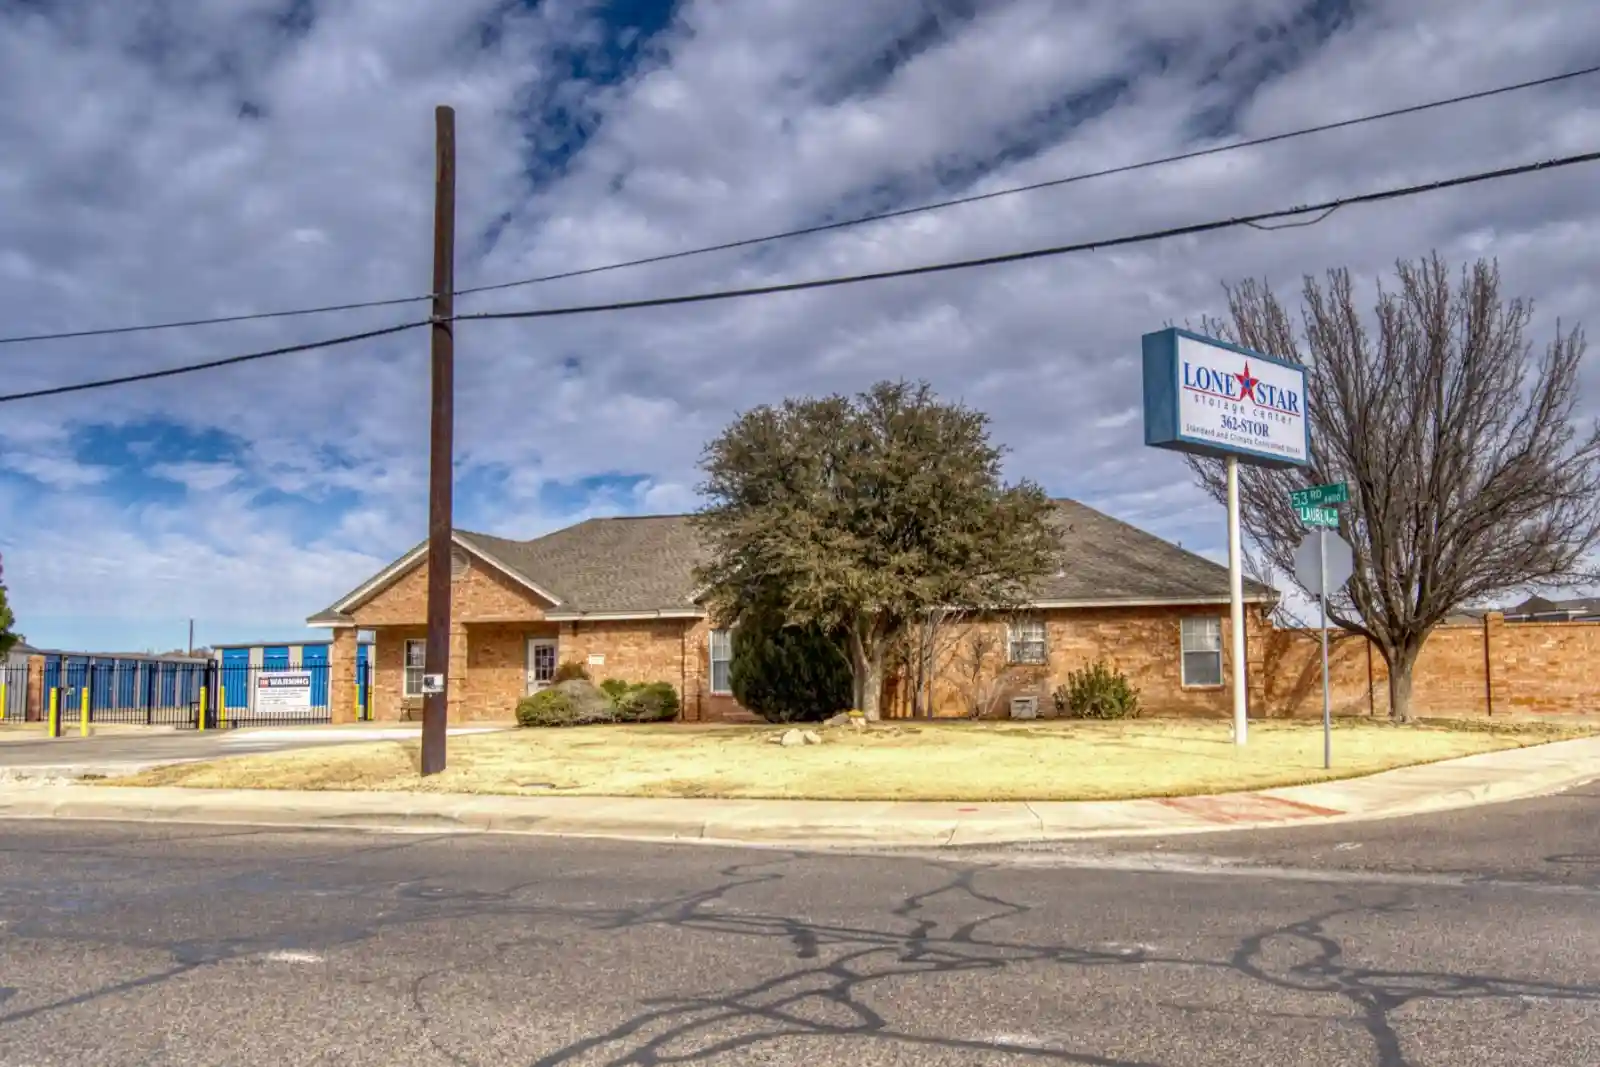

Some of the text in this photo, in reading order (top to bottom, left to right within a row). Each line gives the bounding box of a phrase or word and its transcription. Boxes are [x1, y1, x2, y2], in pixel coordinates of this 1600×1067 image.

[1183, 362, 1299, 413] LONE STAR
[1194, 394, 1292, 425] storage center
[1216, 430, 1229, 440] and
[1220, 414, 1269, 438] 362-STOR
